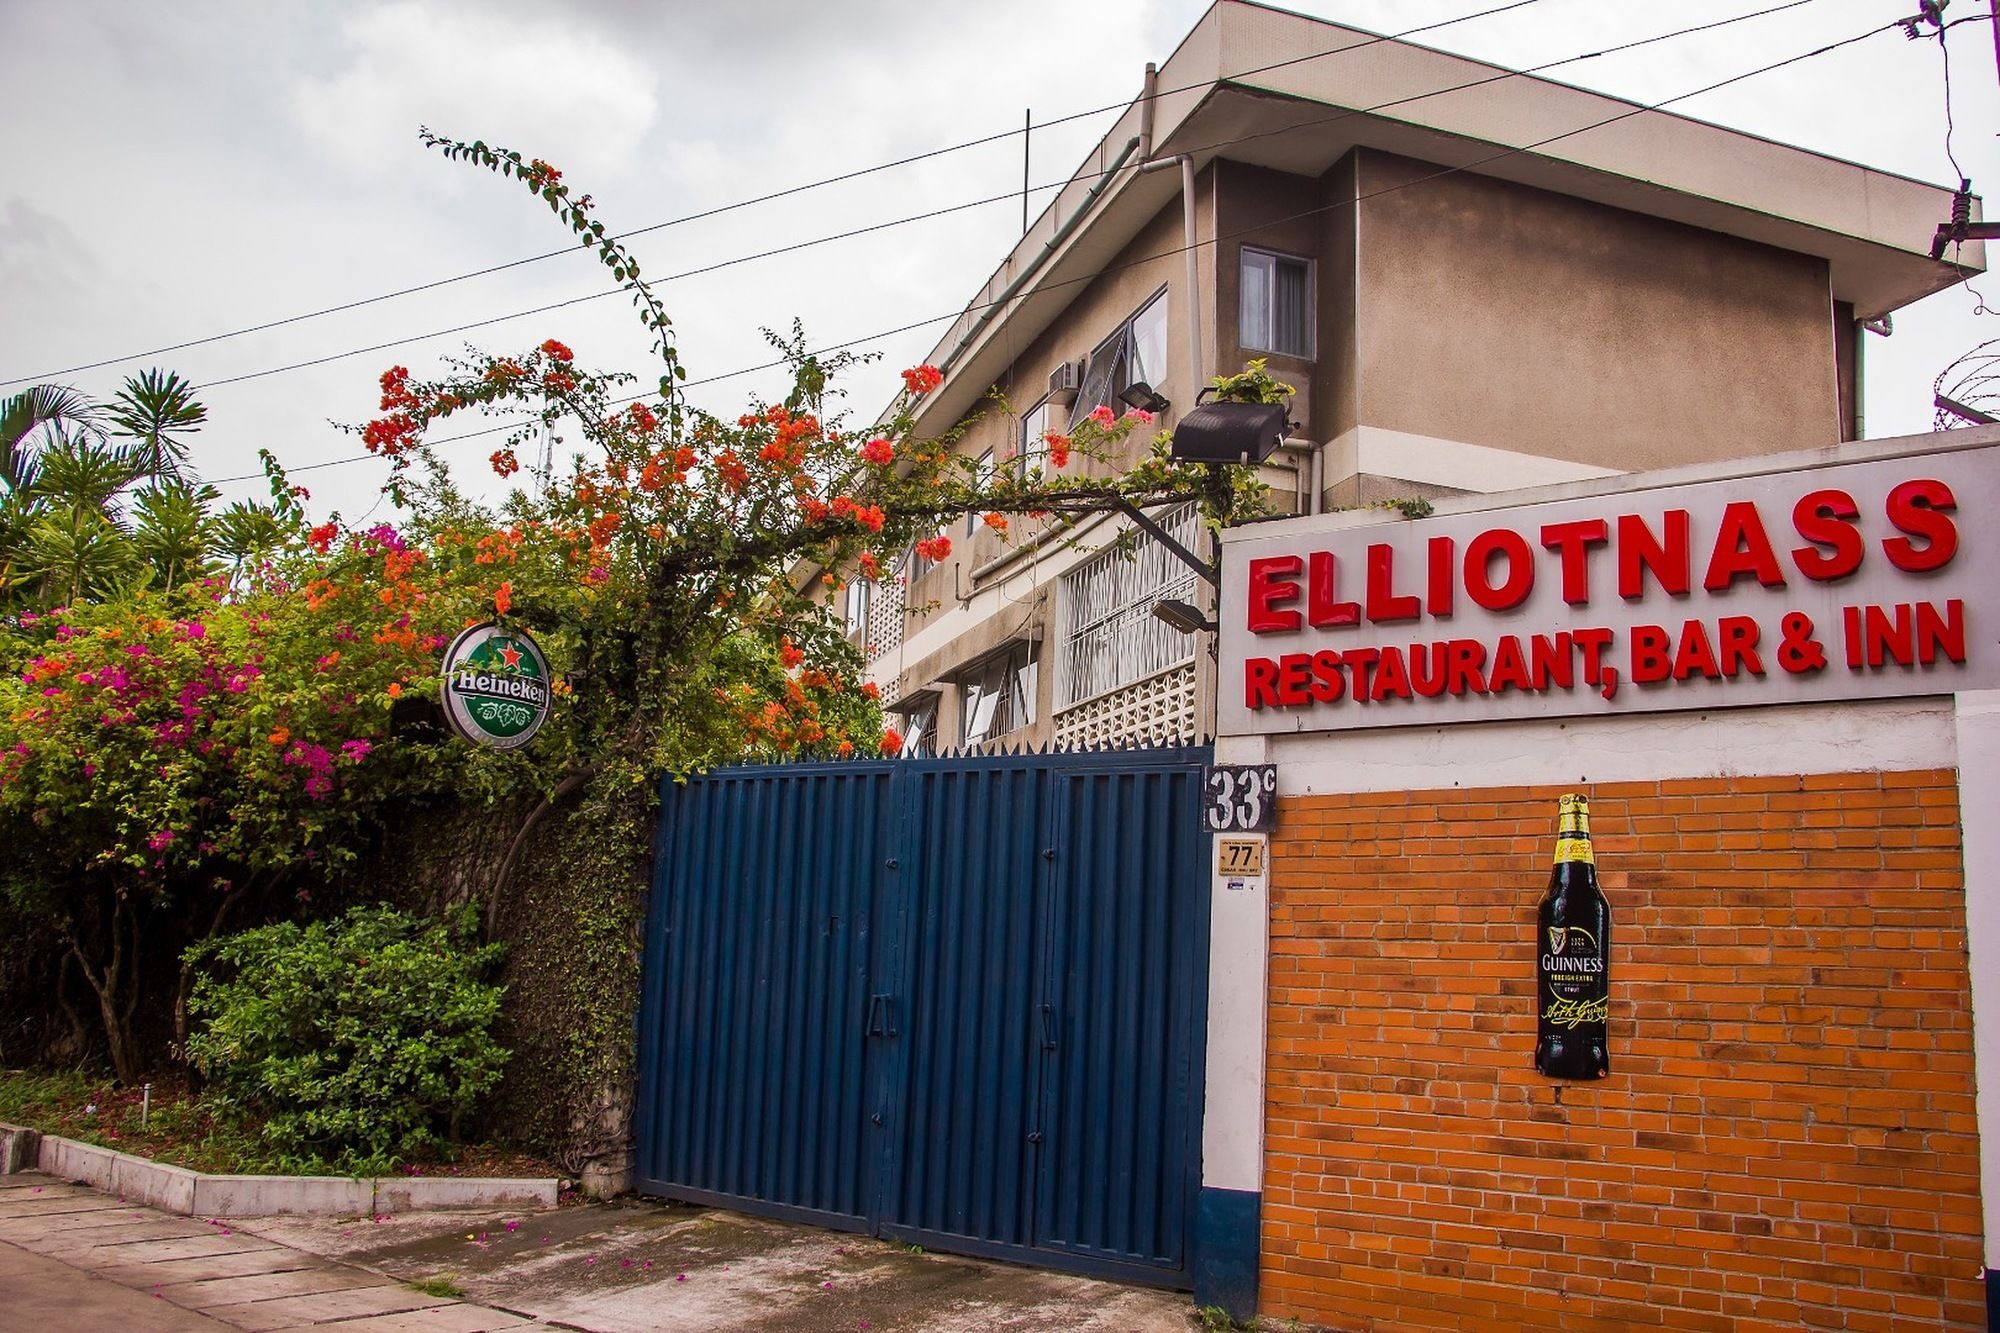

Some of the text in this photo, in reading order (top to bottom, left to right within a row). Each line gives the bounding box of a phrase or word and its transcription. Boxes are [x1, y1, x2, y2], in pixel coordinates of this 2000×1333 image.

[1247, 480, 1959, 634] ELLIOTNASS
[1245, 598, 1966, 710] RESTAURANT, BAR & INN
[458, 669, 545, 702] Heineken
[1229, 846, 1253, 866] 77
[1542, 953, 1603, 973] GUINNESS
